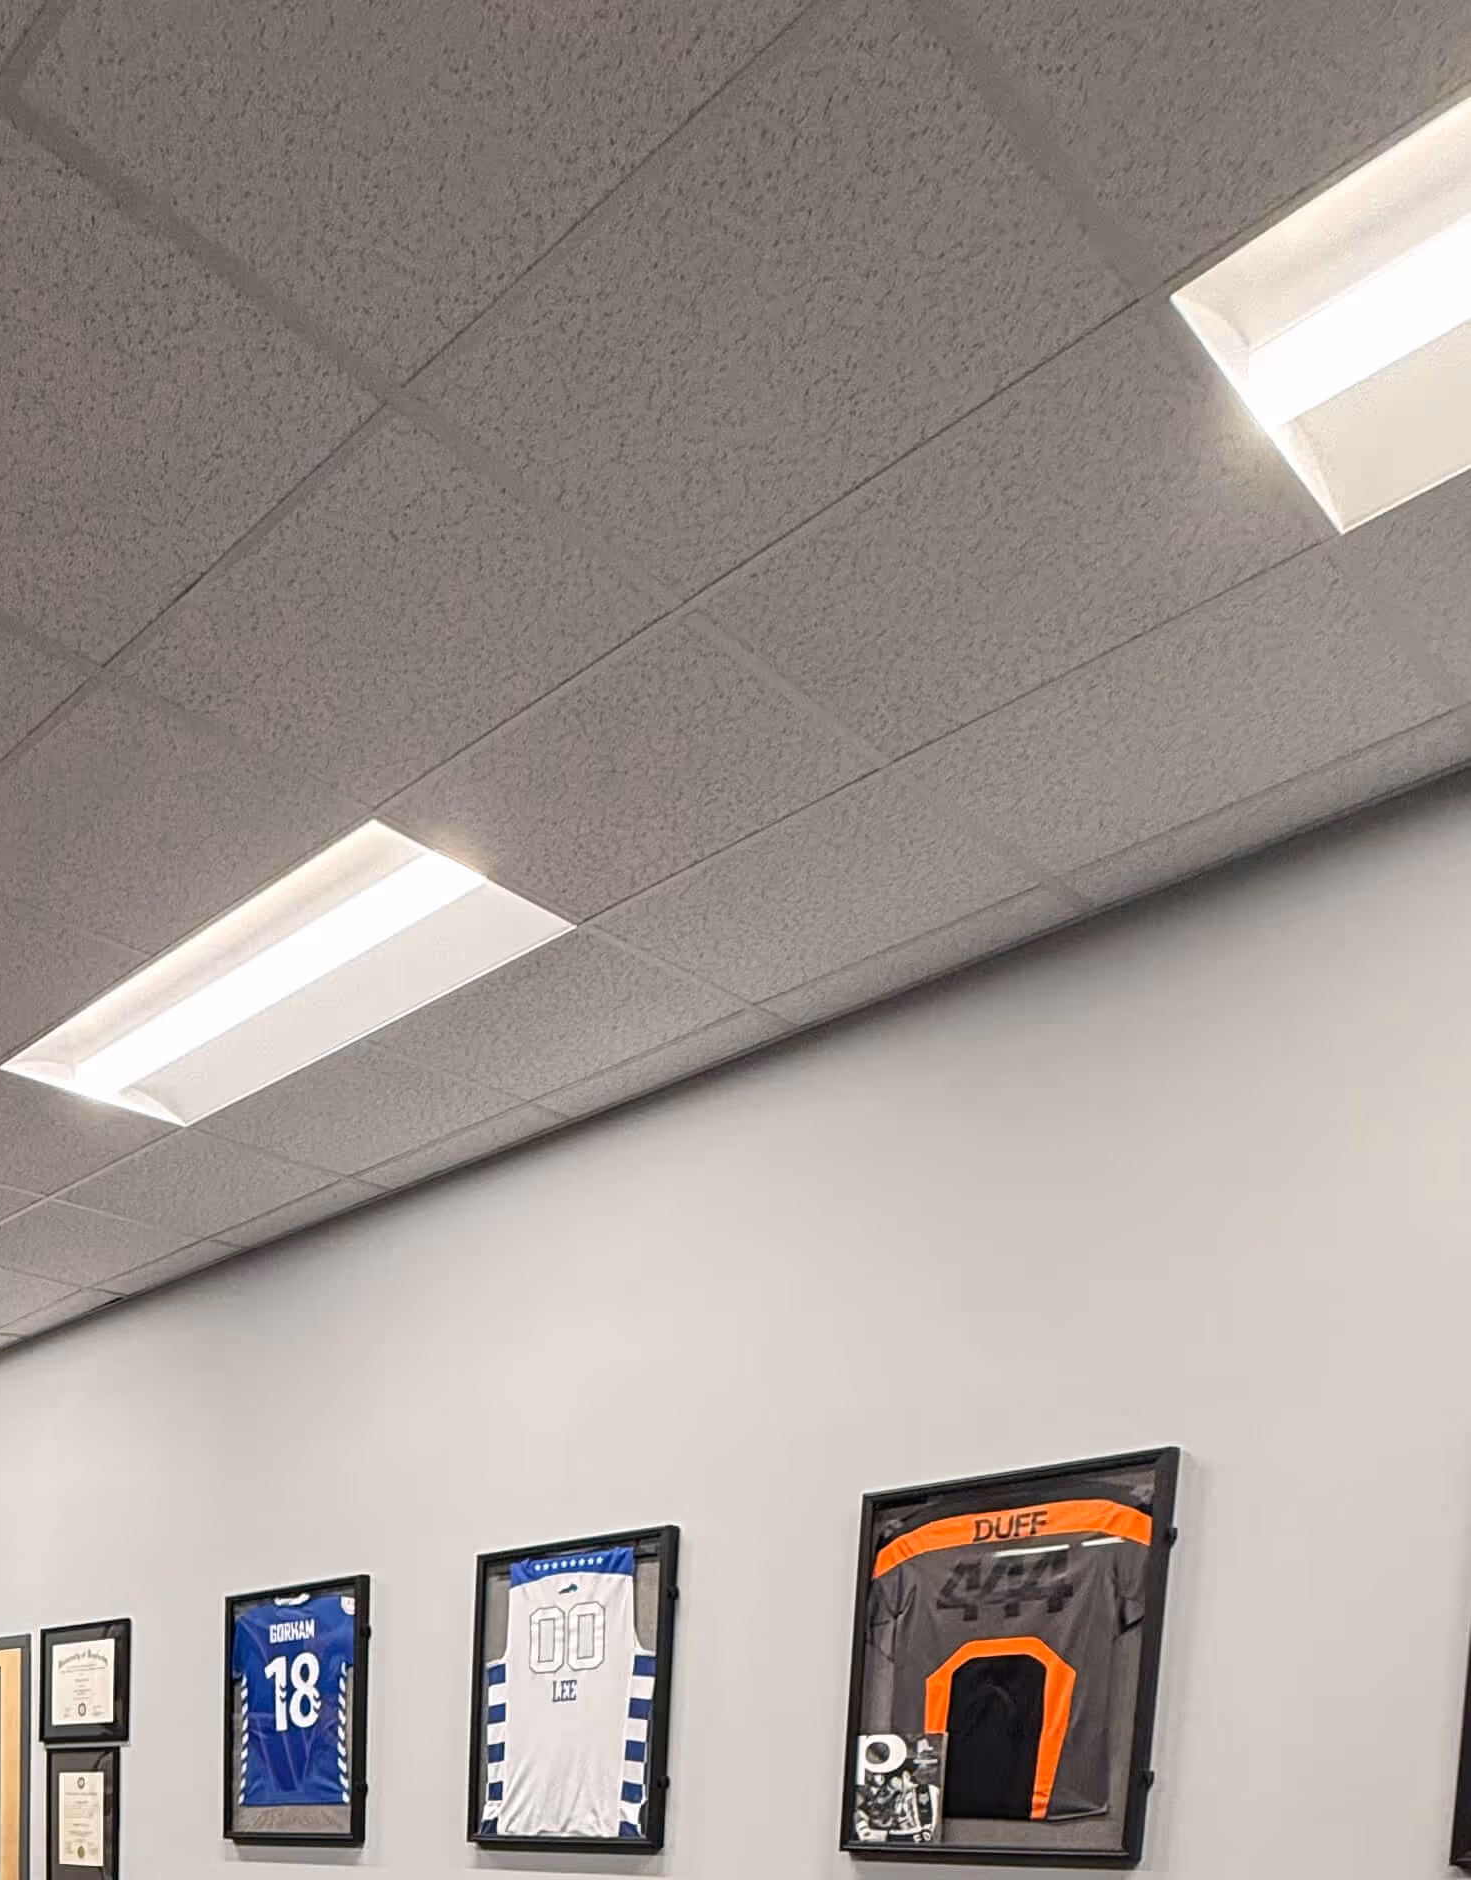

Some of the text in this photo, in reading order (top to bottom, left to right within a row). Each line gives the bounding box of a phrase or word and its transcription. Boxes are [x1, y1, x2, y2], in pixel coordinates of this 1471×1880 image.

[972, 1510, 1048, 1543] DUFF
[269, 1618, 315, 1644] GORHAM
[529, 1601, 606, 1674] 00
[264, 1652, 321, 1732] 18
[551, 1679, 578, 1703] LEE
